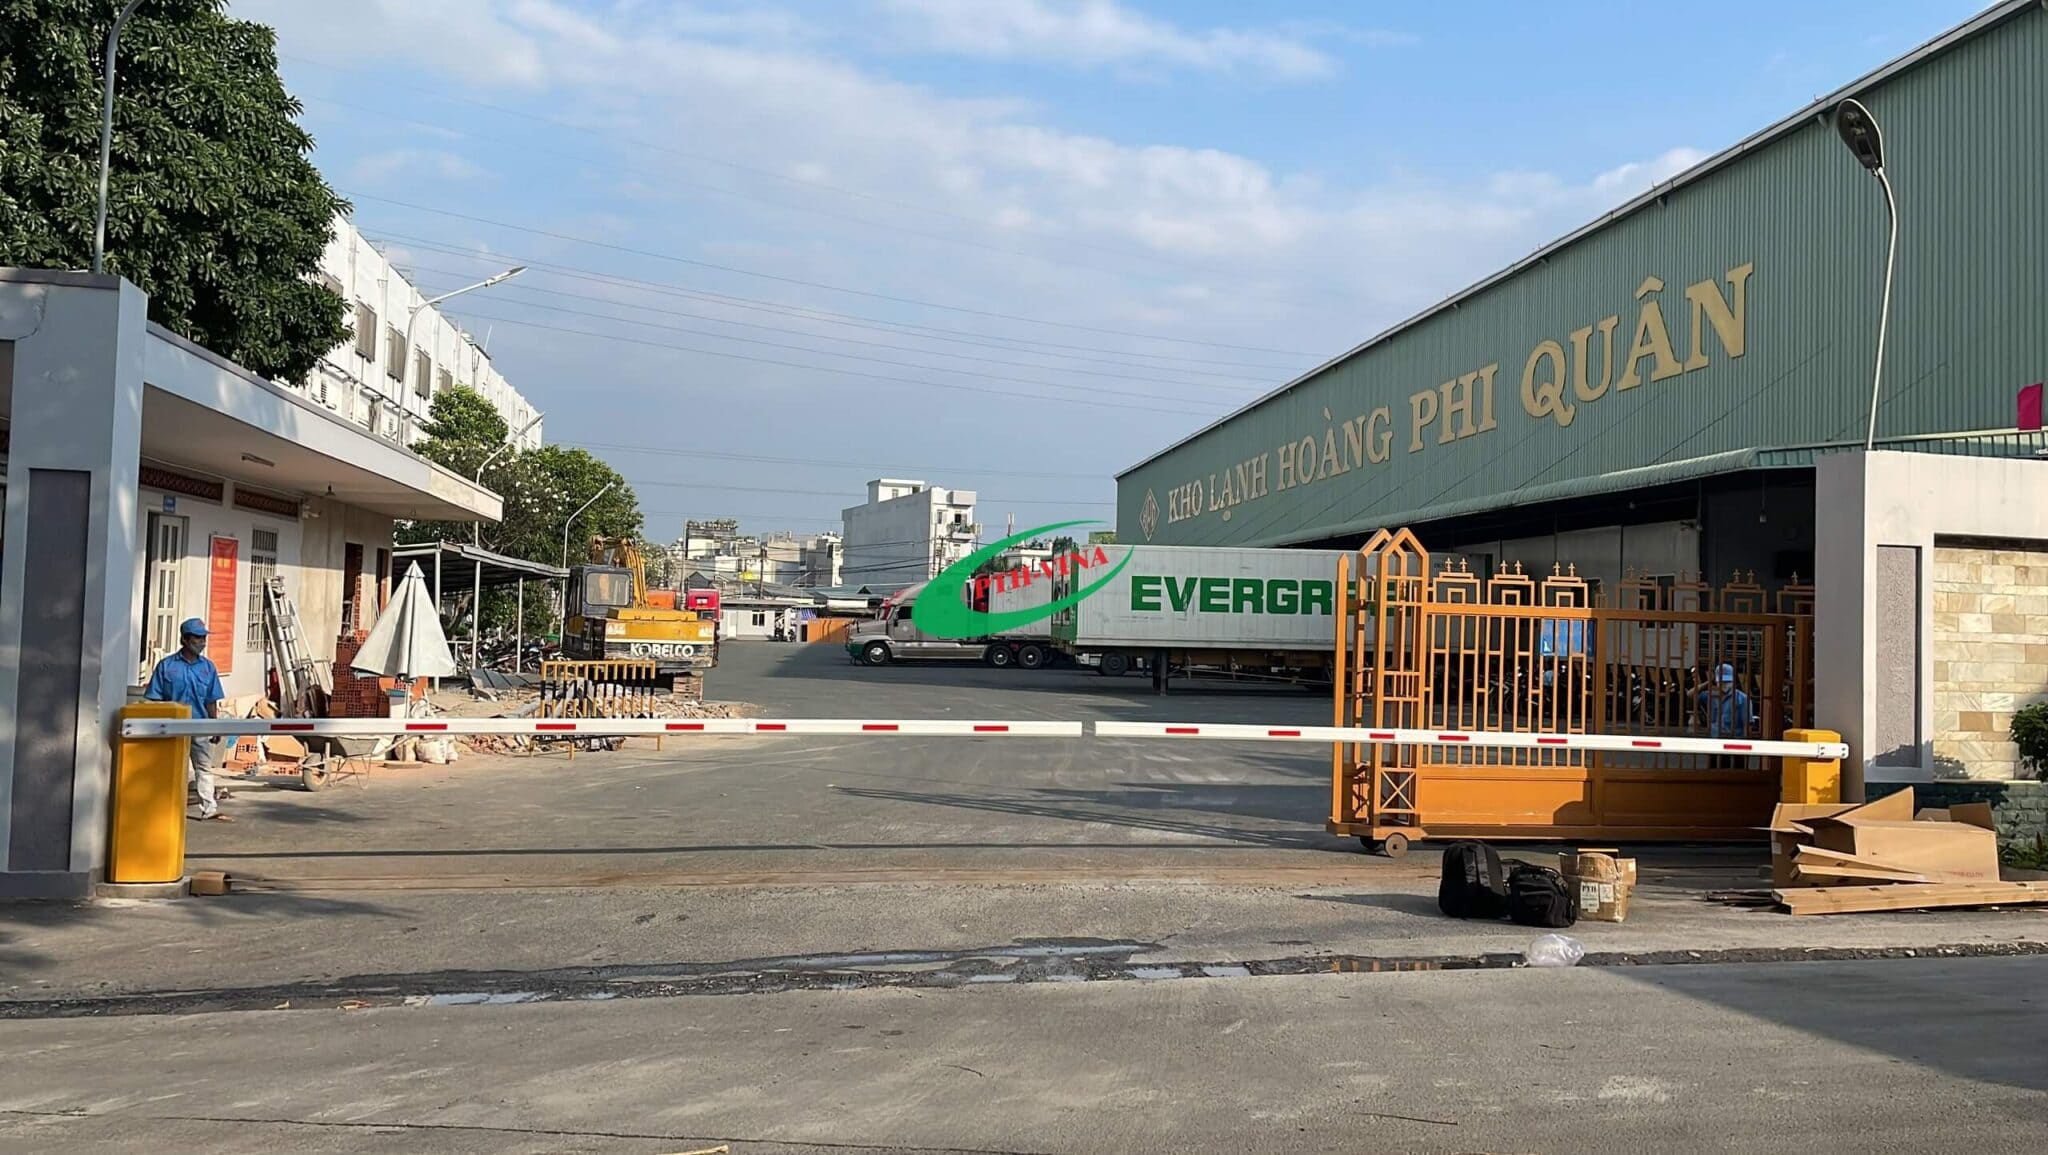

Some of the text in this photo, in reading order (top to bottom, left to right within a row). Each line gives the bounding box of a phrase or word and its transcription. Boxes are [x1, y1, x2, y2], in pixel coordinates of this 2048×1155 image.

[1168, 480, 1203, 523] KHO
[1209, 453, 1269, 521] LẠNH
[1277, 406, 1393, 492] HOÀNG
[1408, 362, 1498, 453] PHI
[1521, 262, 1754, 428] QUÂN
[630, 643, 694, 658] KOBELCO
